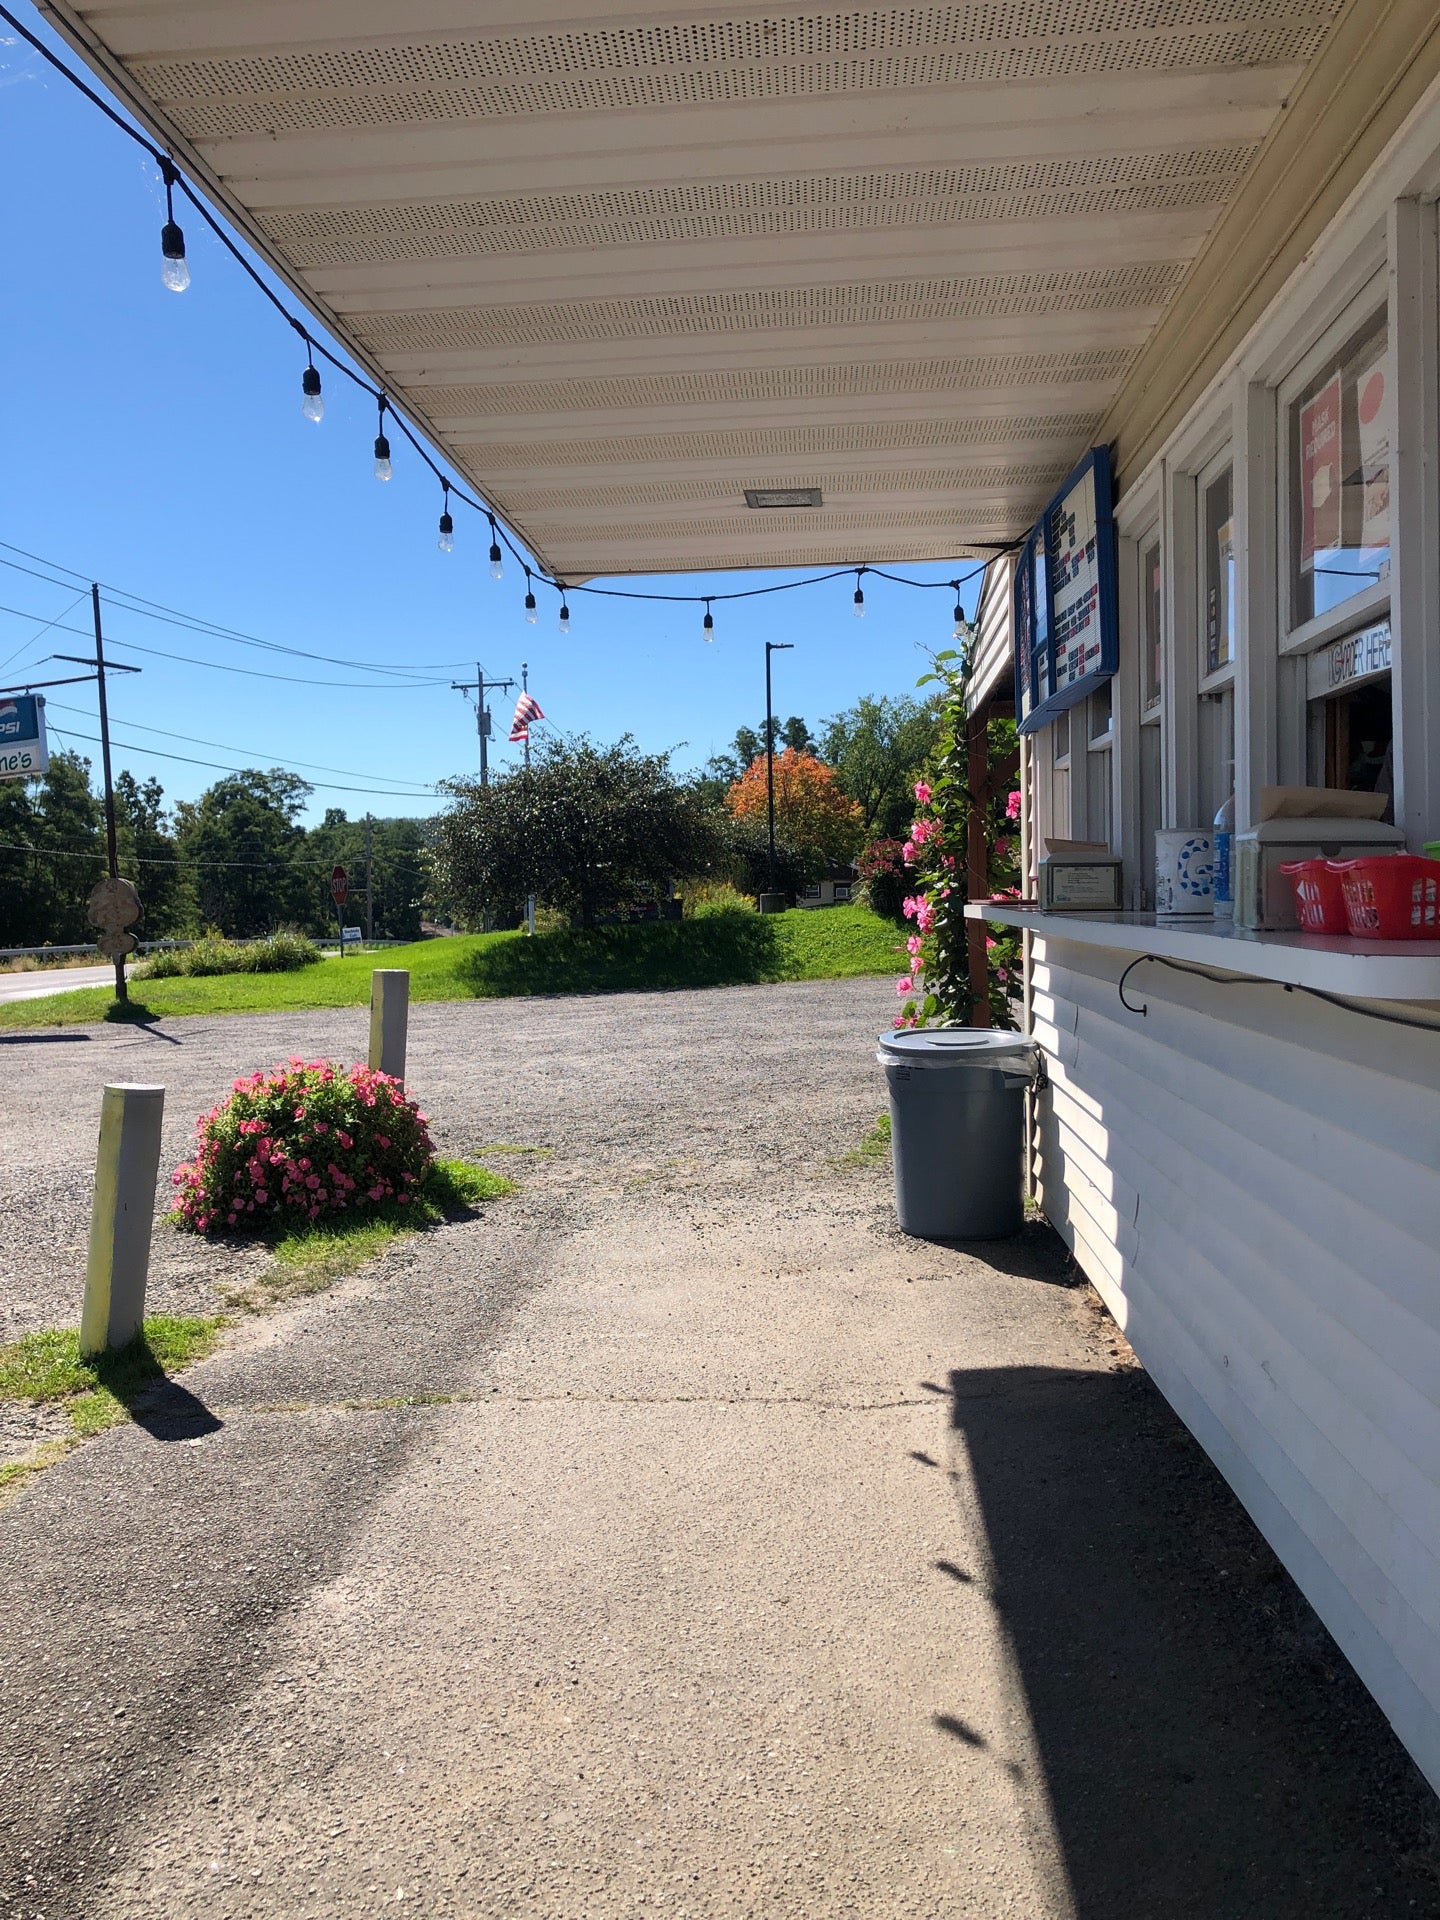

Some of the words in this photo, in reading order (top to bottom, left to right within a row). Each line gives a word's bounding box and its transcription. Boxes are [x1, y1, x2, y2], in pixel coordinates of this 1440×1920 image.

[1312, 405, 1330, 437] MASK
[1366, 628, 1391, 672] HERE
[332, 877, 347, 893] STOP
